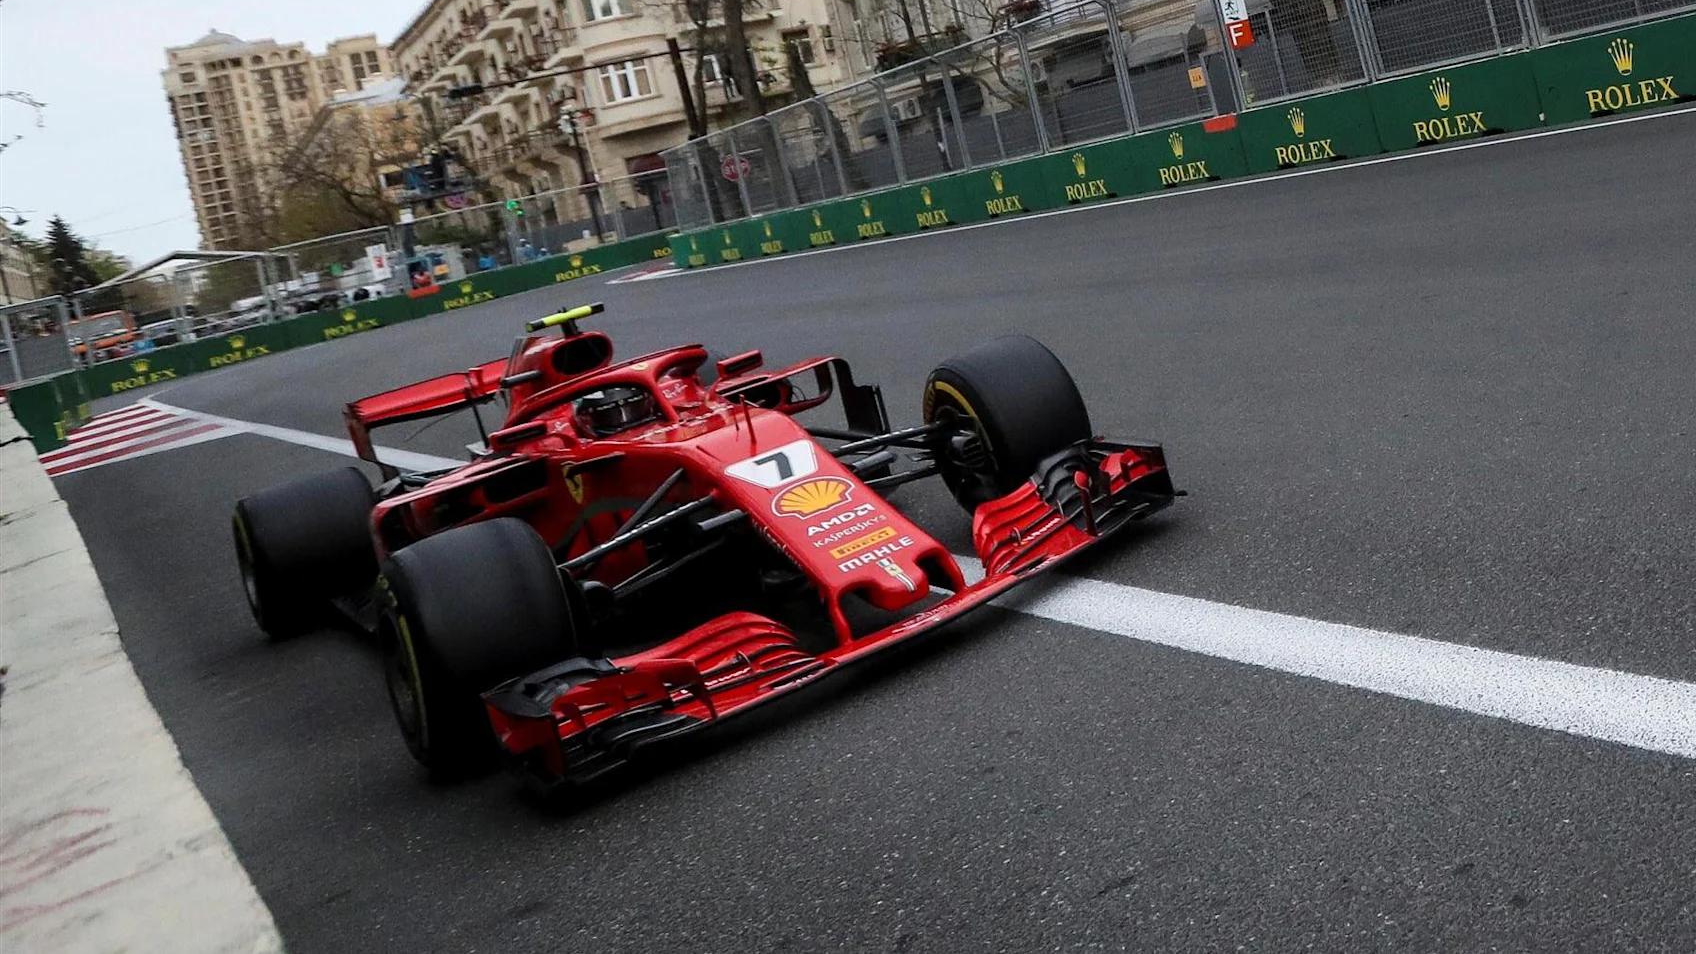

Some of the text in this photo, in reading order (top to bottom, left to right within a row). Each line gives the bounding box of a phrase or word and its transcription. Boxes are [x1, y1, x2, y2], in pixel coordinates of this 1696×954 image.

[1229, 23, 1244, 46] F
[1586, 76, 1680, 113] ROLEX
[1414, 111, 1486, 142] ROLEX
[1276, 139, 1335, 165] ROLEX
[1159, 161, 1209, 185] ROLEX
[1065, 179, 1107, 200] ROLEX
[986, 196, 1022, 214] ROLEX
[917, 210, 949, 226] ROLEX
[555, 264, 602, 283] ROLEX
[443, 290, 495, 310] ROLEX
[323, 318, 378, 339] ROLEX
[210, 345, 270, 367] ROLEX
[111, 368, 177, 392] ROLEX
[754, 451, 793, 480] 7
[807, 511, 856, 536] AMD
[813, 515, 880, 548] KASPERSKY
[837, 535, 915, 573] MAHLE
